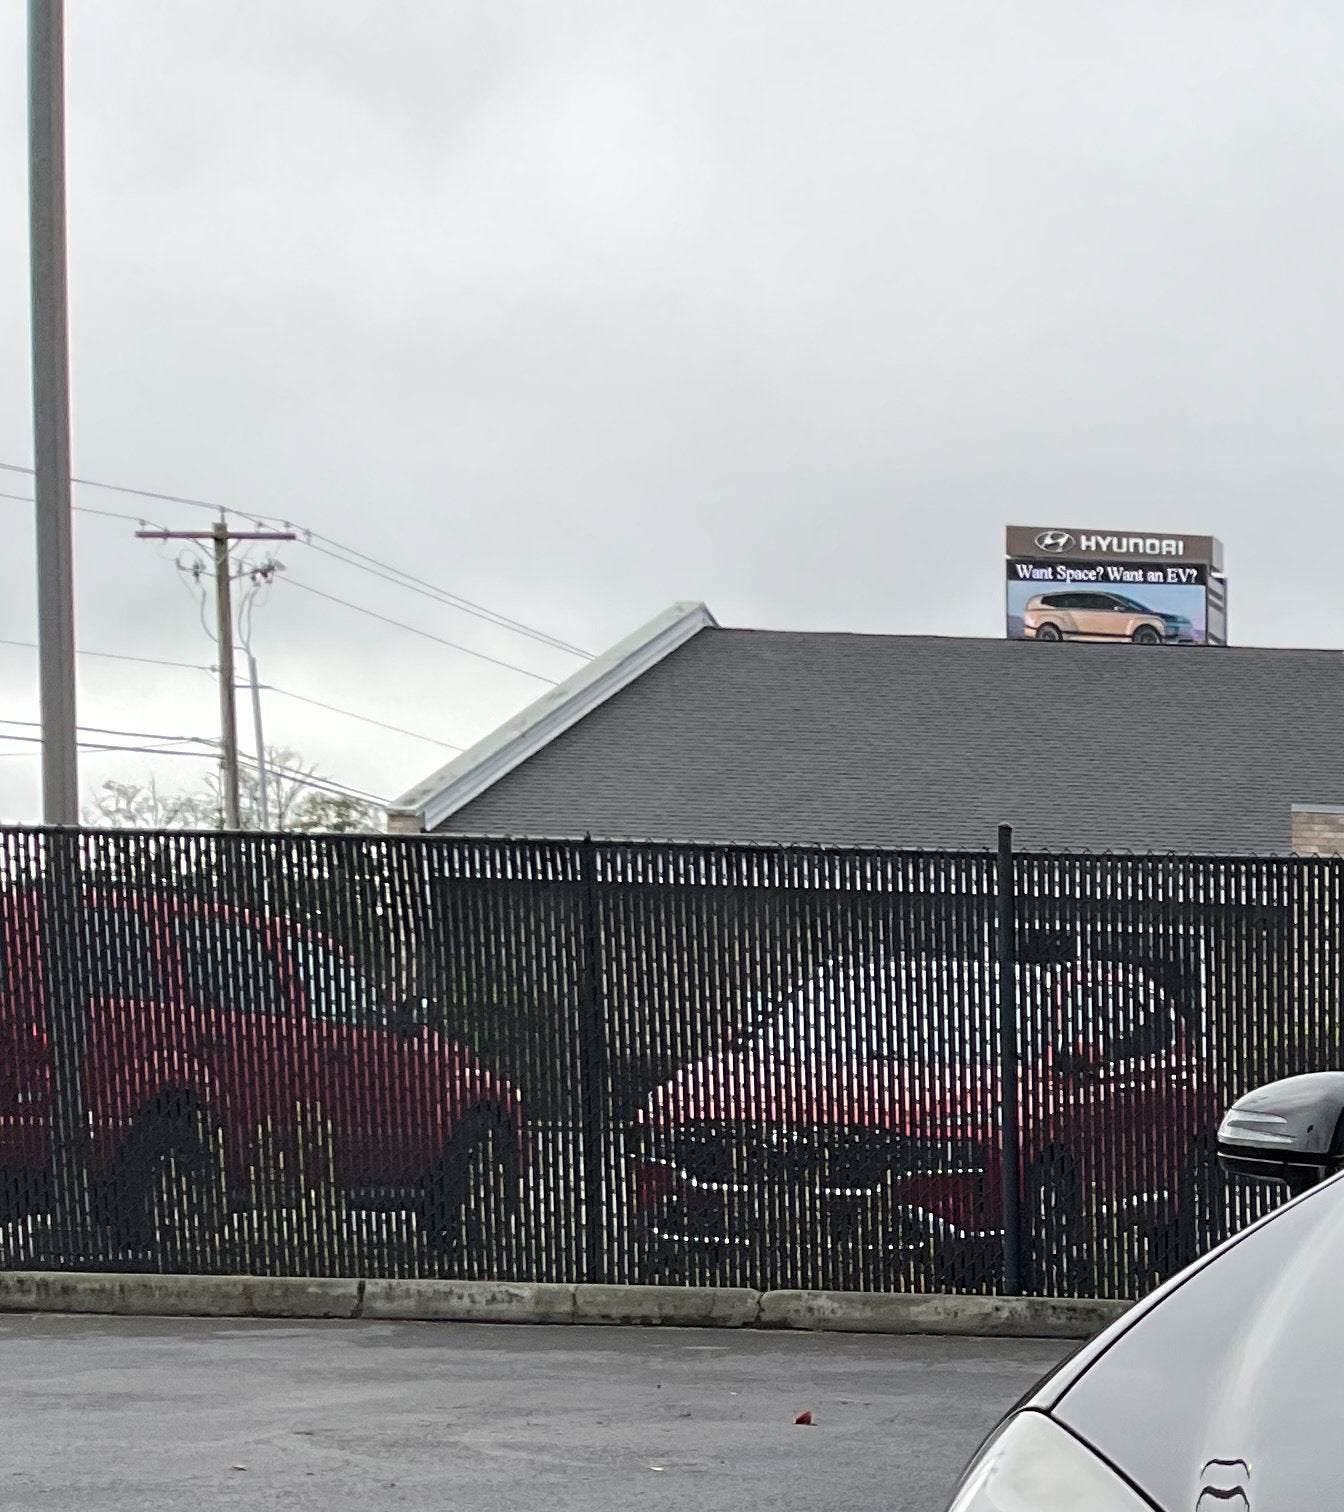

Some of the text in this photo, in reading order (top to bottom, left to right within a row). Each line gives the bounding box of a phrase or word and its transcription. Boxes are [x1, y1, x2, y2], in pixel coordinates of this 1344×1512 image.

[1080, 534, 1184, 556] HYUNDAI
[1015, 563, 1198, 583] Want Space? Want an EV?
